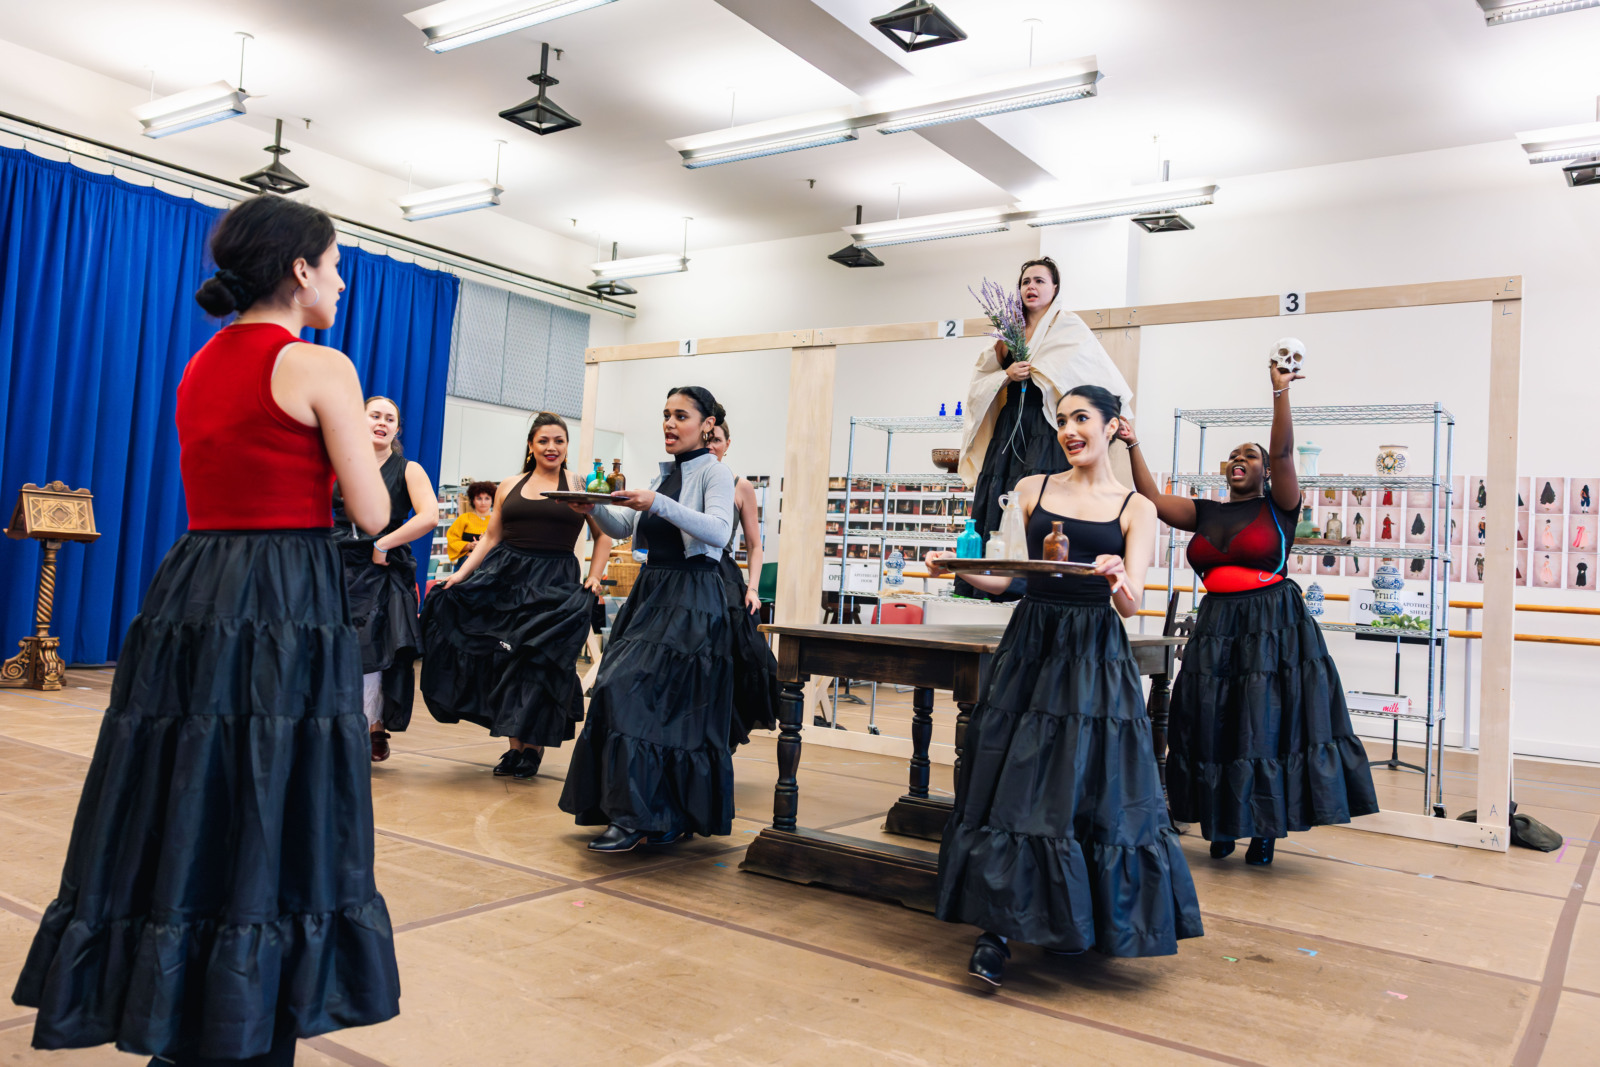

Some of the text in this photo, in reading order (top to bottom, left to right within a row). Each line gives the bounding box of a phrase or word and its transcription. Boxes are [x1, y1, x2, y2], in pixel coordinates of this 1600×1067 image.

[1286, 292, 1299, 312] 3
[946, 320, 956, 337] 2
[685, 339, 691, 353] 1
[1382, 702, 1399, 713] milk
[1489, 804, 1499, 816] A
